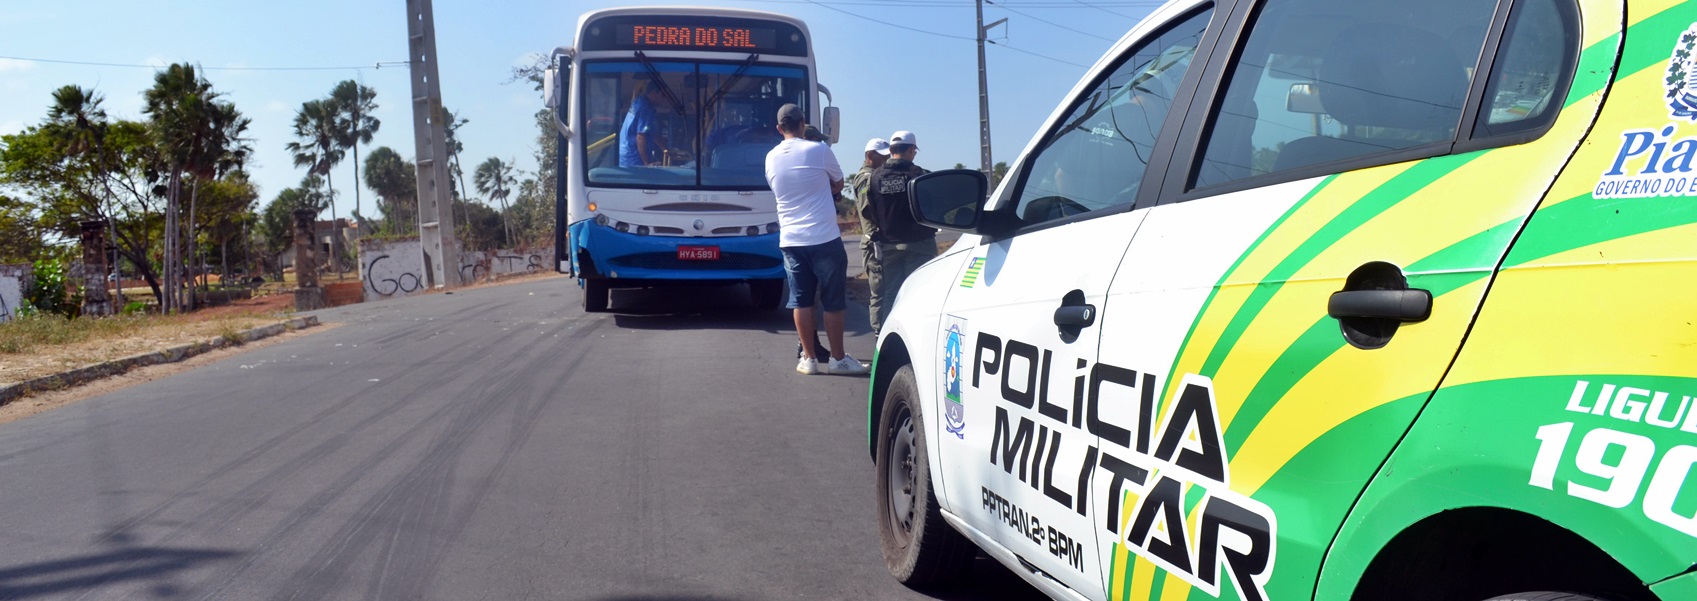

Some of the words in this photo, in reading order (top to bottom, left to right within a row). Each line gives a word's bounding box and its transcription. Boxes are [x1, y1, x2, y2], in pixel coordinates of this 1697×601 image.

[634, 25, 691, 45] PEDRA
[695, 27, 718, 46] DO
[722, 28, 756, 47] SAL
[1595, 178, 1662, 196] GOVERNO
[1664, 177, 1687, 194] DO
[679, 250, 717, 259] HYA-5891
[990, 405, 1271, 601] MILITAR
[1048, 525, 1084, 573] BPM
